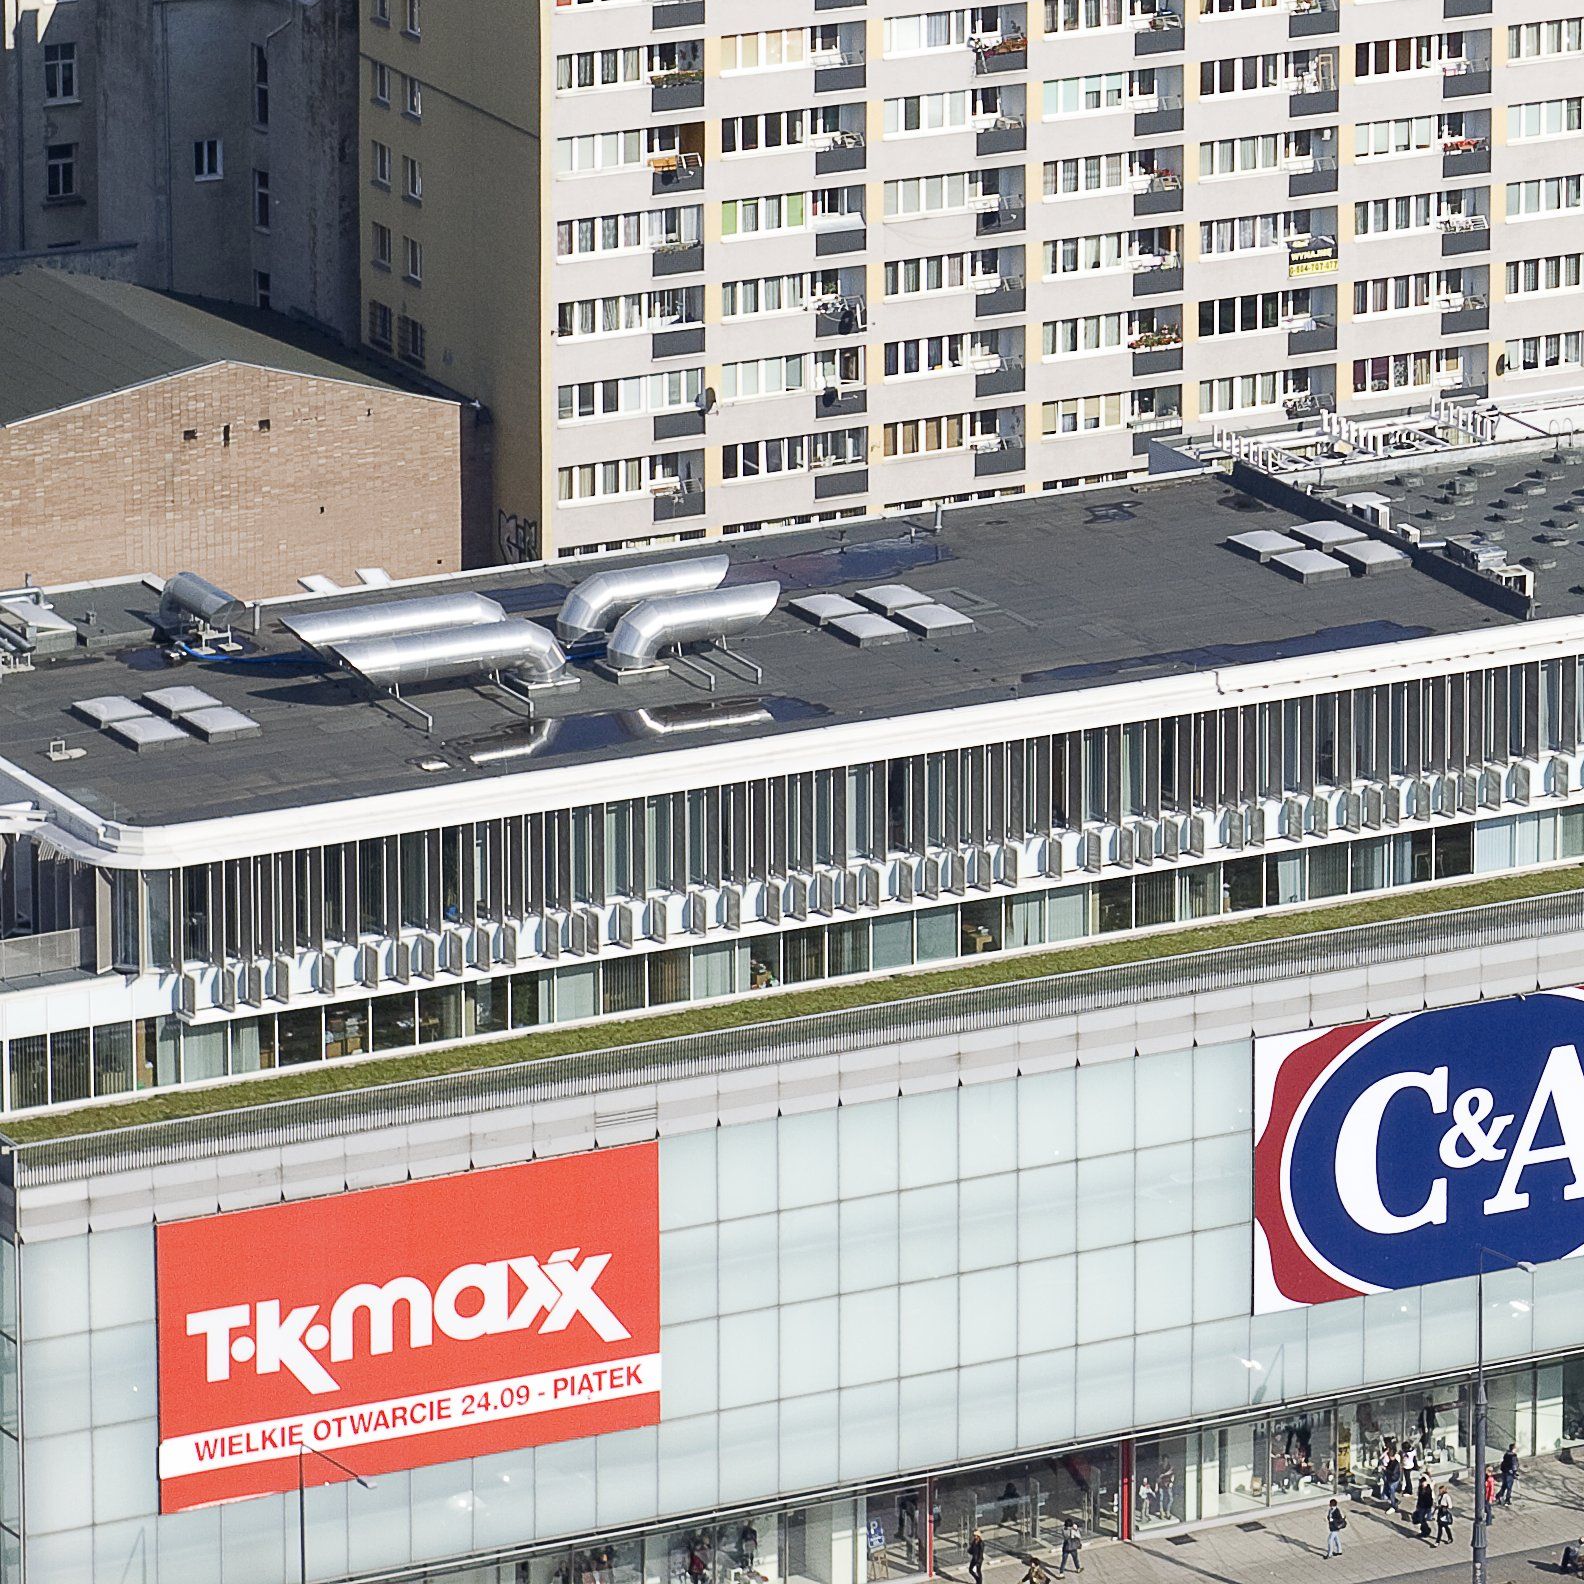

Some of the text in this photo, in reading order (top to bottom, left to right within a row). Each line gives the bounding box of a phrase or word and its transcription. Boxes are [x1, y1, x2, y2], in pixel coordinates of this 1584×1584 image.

[194, 1421, 304, 1463] WIELKIE
[312, 1397, 453, 1443] OTWARCIE
[460, 1383, 532, 1418] 24.09
[553, 1362, 645, 1402] PIĄTEK
